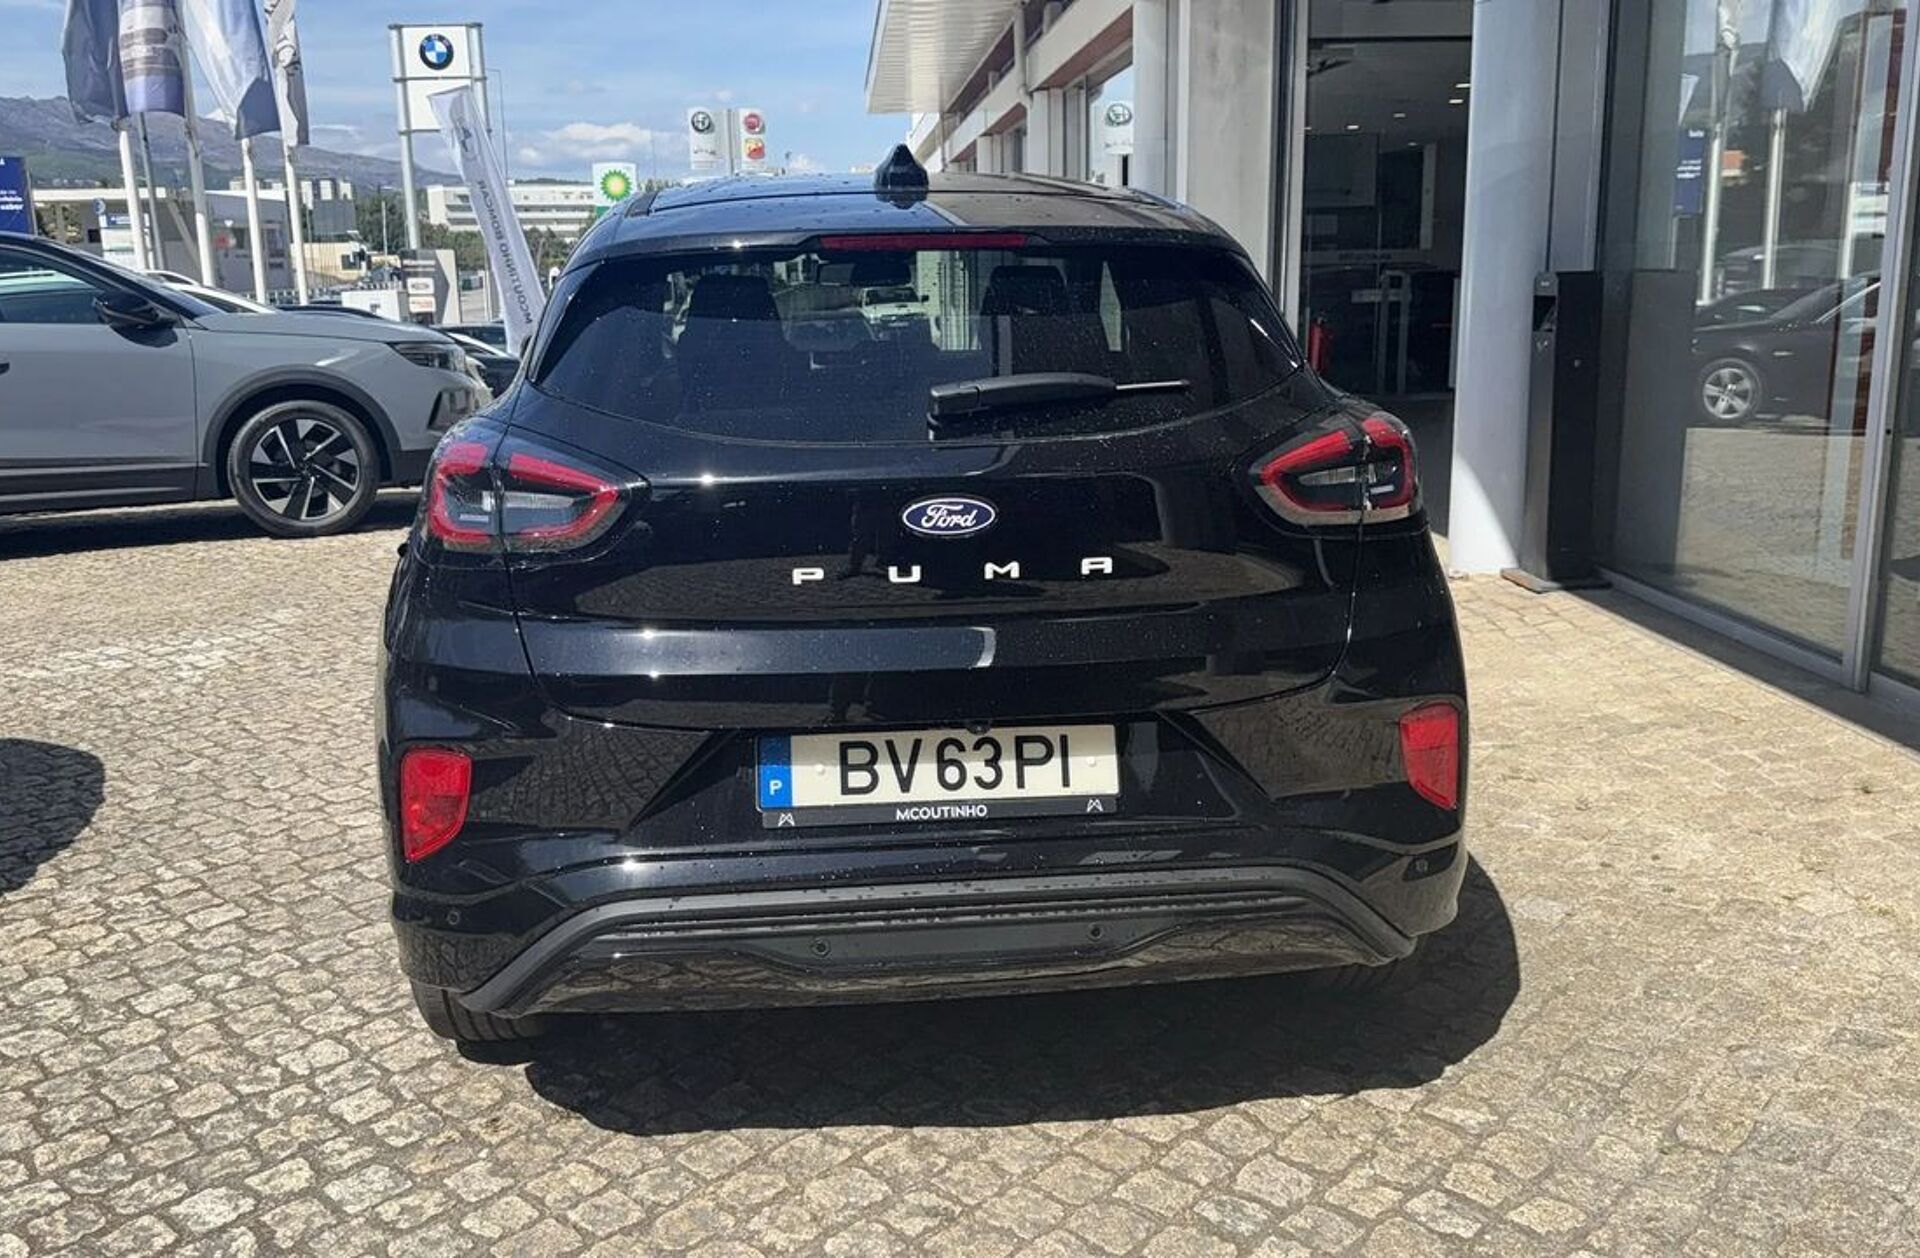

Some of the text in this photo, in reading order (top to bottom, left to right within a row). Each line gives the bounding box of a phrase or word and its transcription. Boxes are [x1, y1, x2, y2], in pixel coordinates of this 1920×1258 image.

[921, 504, 978, 528] Ford
[792, 556, 1113, 585] PUMA
[769, 779, 783, 795] P
[895, 804, 988, 821] MCOUTINHO
